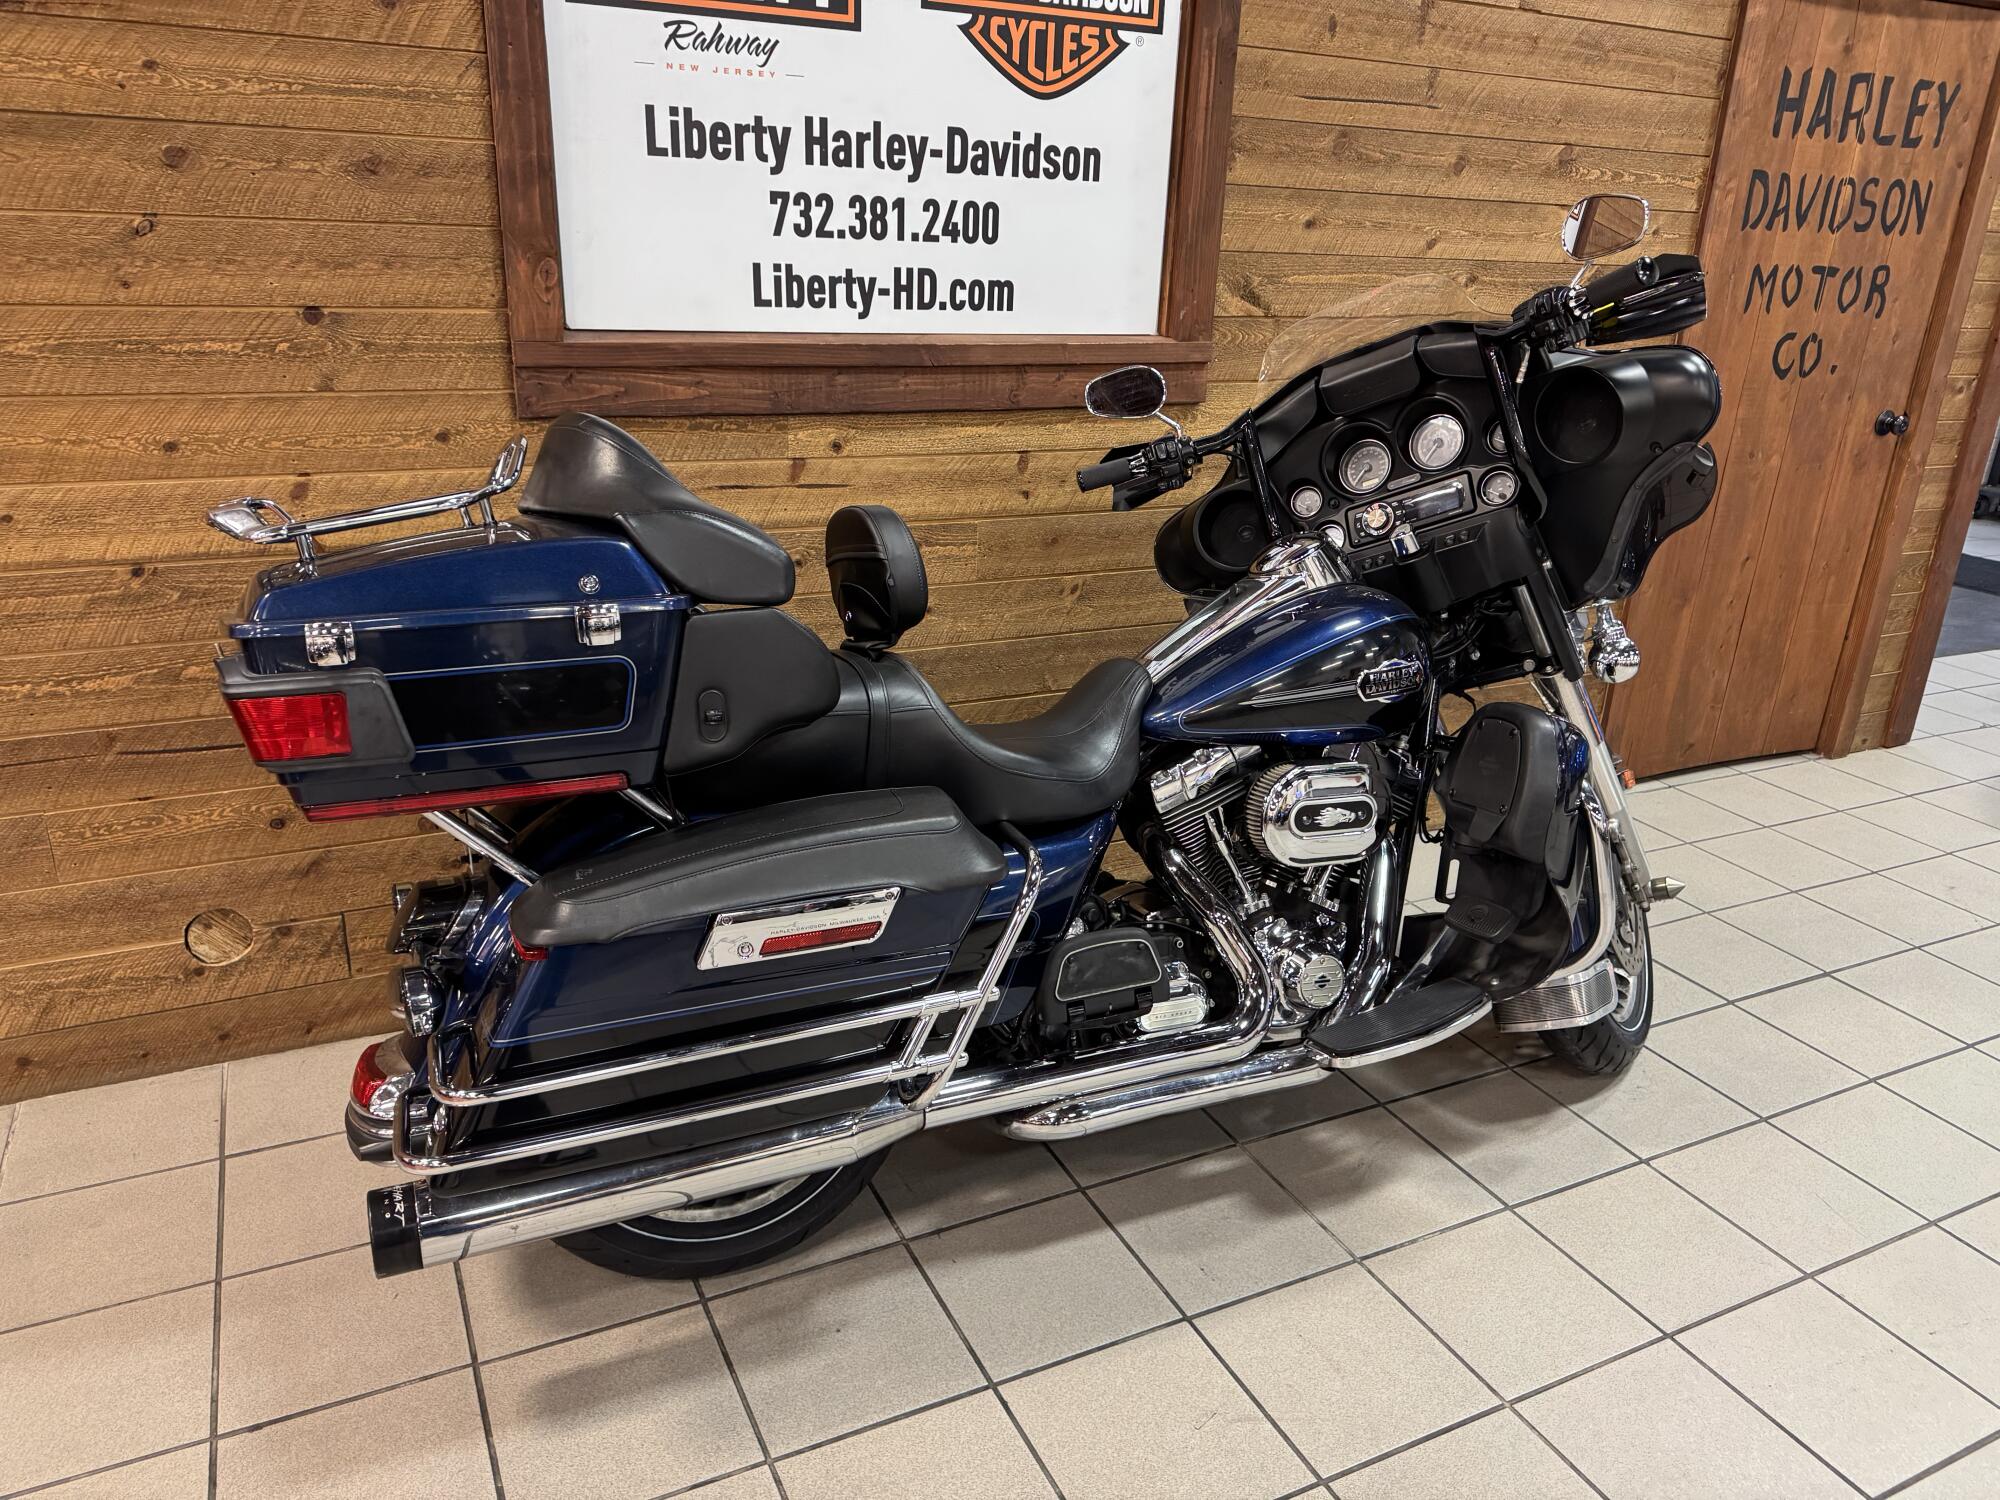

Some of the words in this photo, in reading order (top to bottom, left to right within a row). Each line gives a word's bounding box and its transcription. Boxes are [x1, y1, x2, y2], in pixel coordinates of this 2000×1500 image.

[663, 19, 780, 68] Rahway
[666, 62, 699, 72] NEW
[712, 66, 776, 79] JERSEY
[989, 15, 1100, 82] CYCLES
[1771, 64, 1962, 149] HARLEY
[644, 104, 791, 176] Liberty
[803, 115, 1102, 183] Harley-Davidson
[769, 190, 1000, 246] 732.381.2400
[1741, 168, 1934, 236] DAVIDSON
[751, 262, 1015, 320] Liberty-HD.com
[1743, 263, 1891, 319] MOTOR
[1771, 331, 1839, 381] CO.
